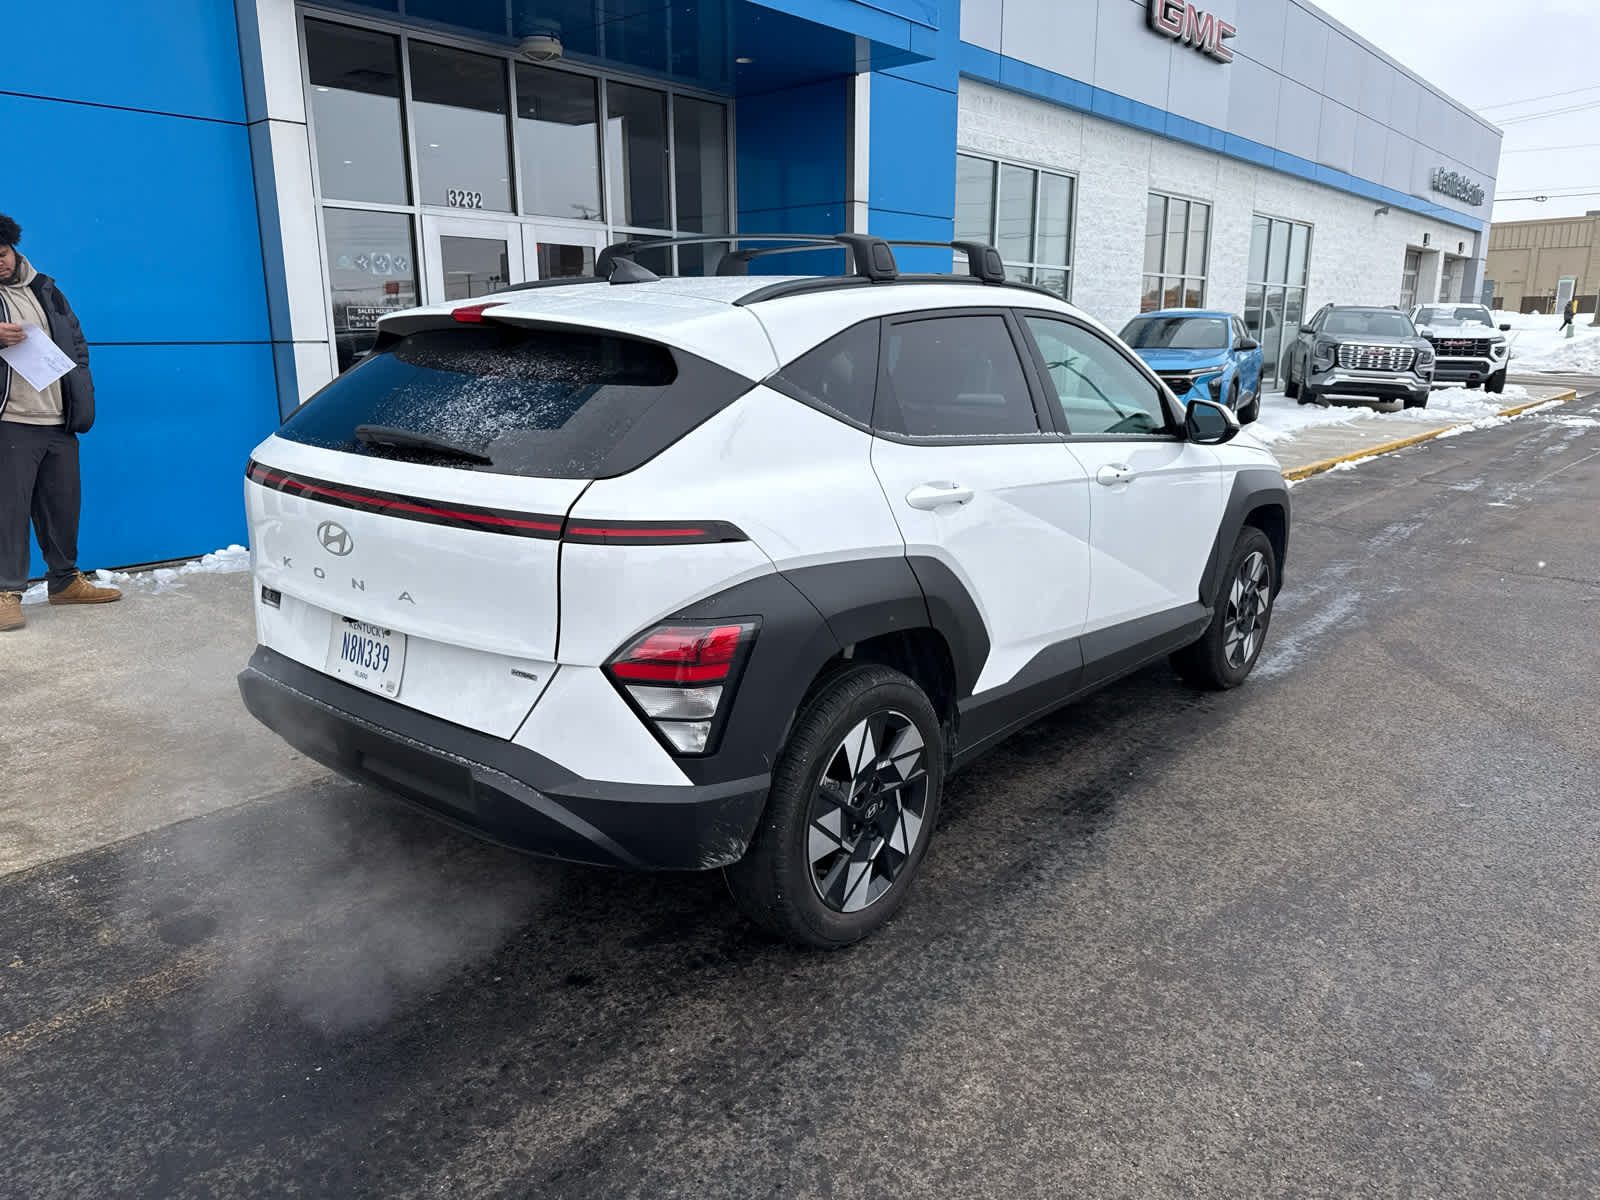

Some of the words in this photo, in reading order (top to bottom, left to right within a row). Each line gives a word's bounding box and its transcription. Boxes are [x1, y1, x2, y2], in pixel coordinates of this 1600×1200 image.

[1150, 0, 1236, 63] GMC
[449, 189, 482, 209] 3232
[282, 555, 416, 605] KONA
[349, 622, 385, 639] KENTUCKY
[341, 631, 390, 673] N8N339
